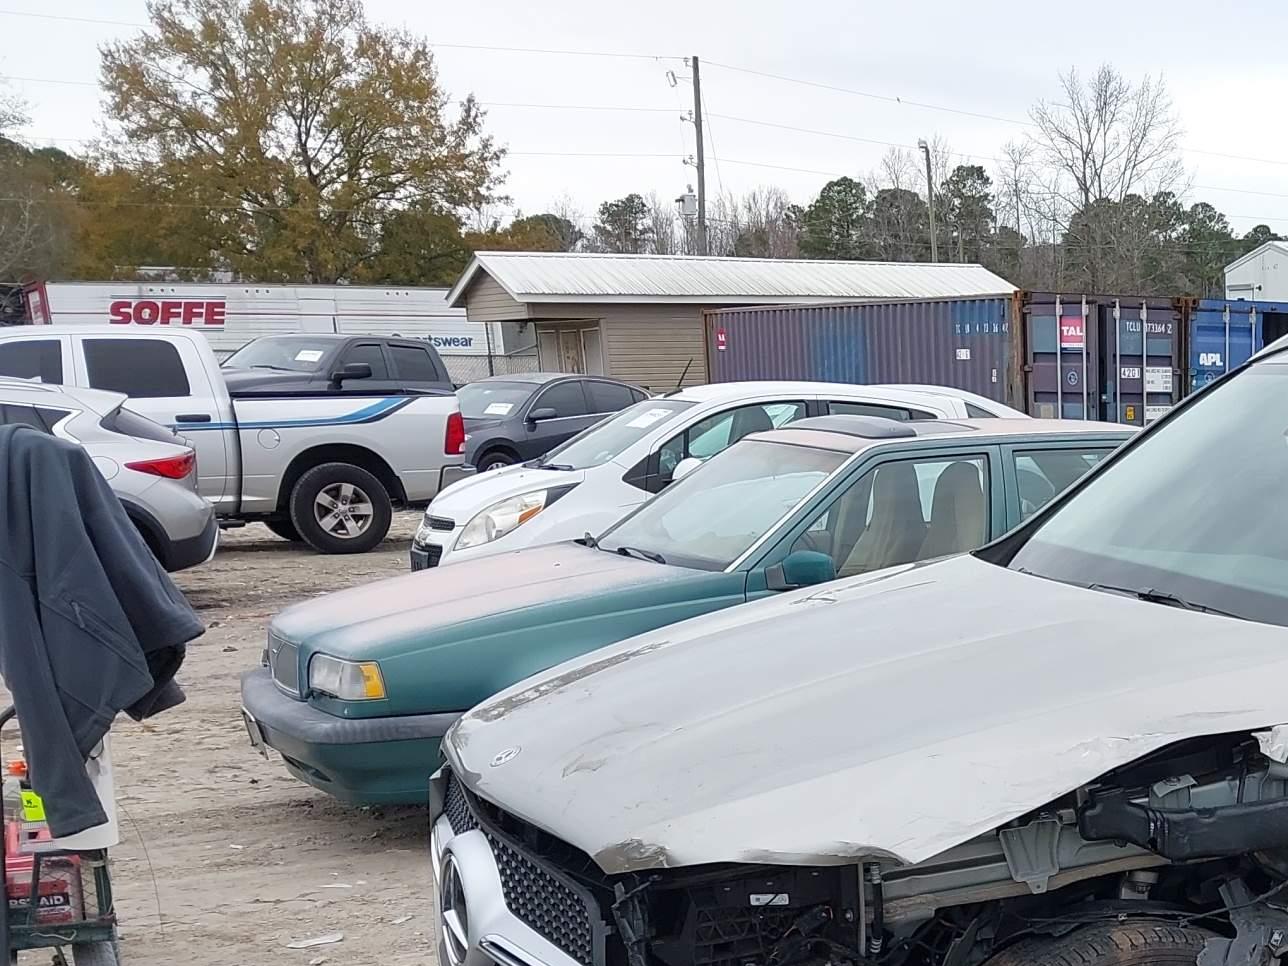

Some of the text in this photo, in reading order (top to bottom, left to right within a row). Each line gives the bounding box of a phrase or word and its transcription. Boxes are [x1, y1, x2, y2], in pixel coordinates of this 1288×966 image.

[109, 300, 226, 325] SOFFE
[1061, 326, 1083, 336] TAL
[1126, 321, 1141, 332] TCLU
[1199, 353, 1224, 366] APL
[40, 895, 64, 906] AID
